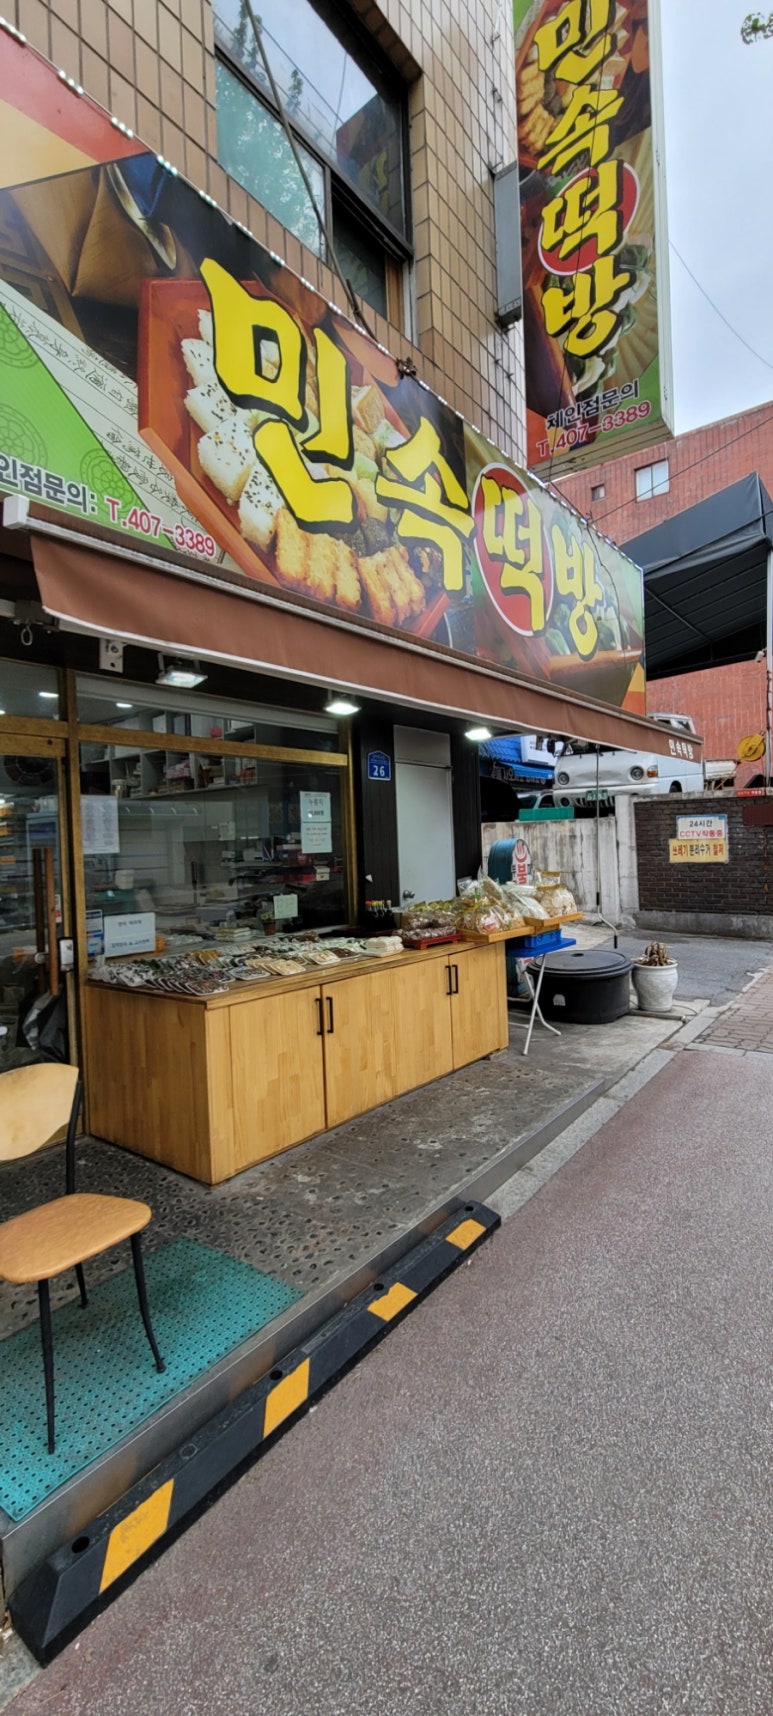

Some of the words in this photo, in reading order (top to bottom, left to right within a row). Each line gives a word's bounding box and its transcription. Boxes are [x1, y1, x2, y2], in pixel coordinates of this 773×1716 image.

[547, 380, 638, 429] 체인점문의
[373, 765, 385, 777] 26
[689, 820, 713, 828] 24시간
[672, 843, 689, 857] 쓰레기
[689, 843, 711, 856] 분리수거
